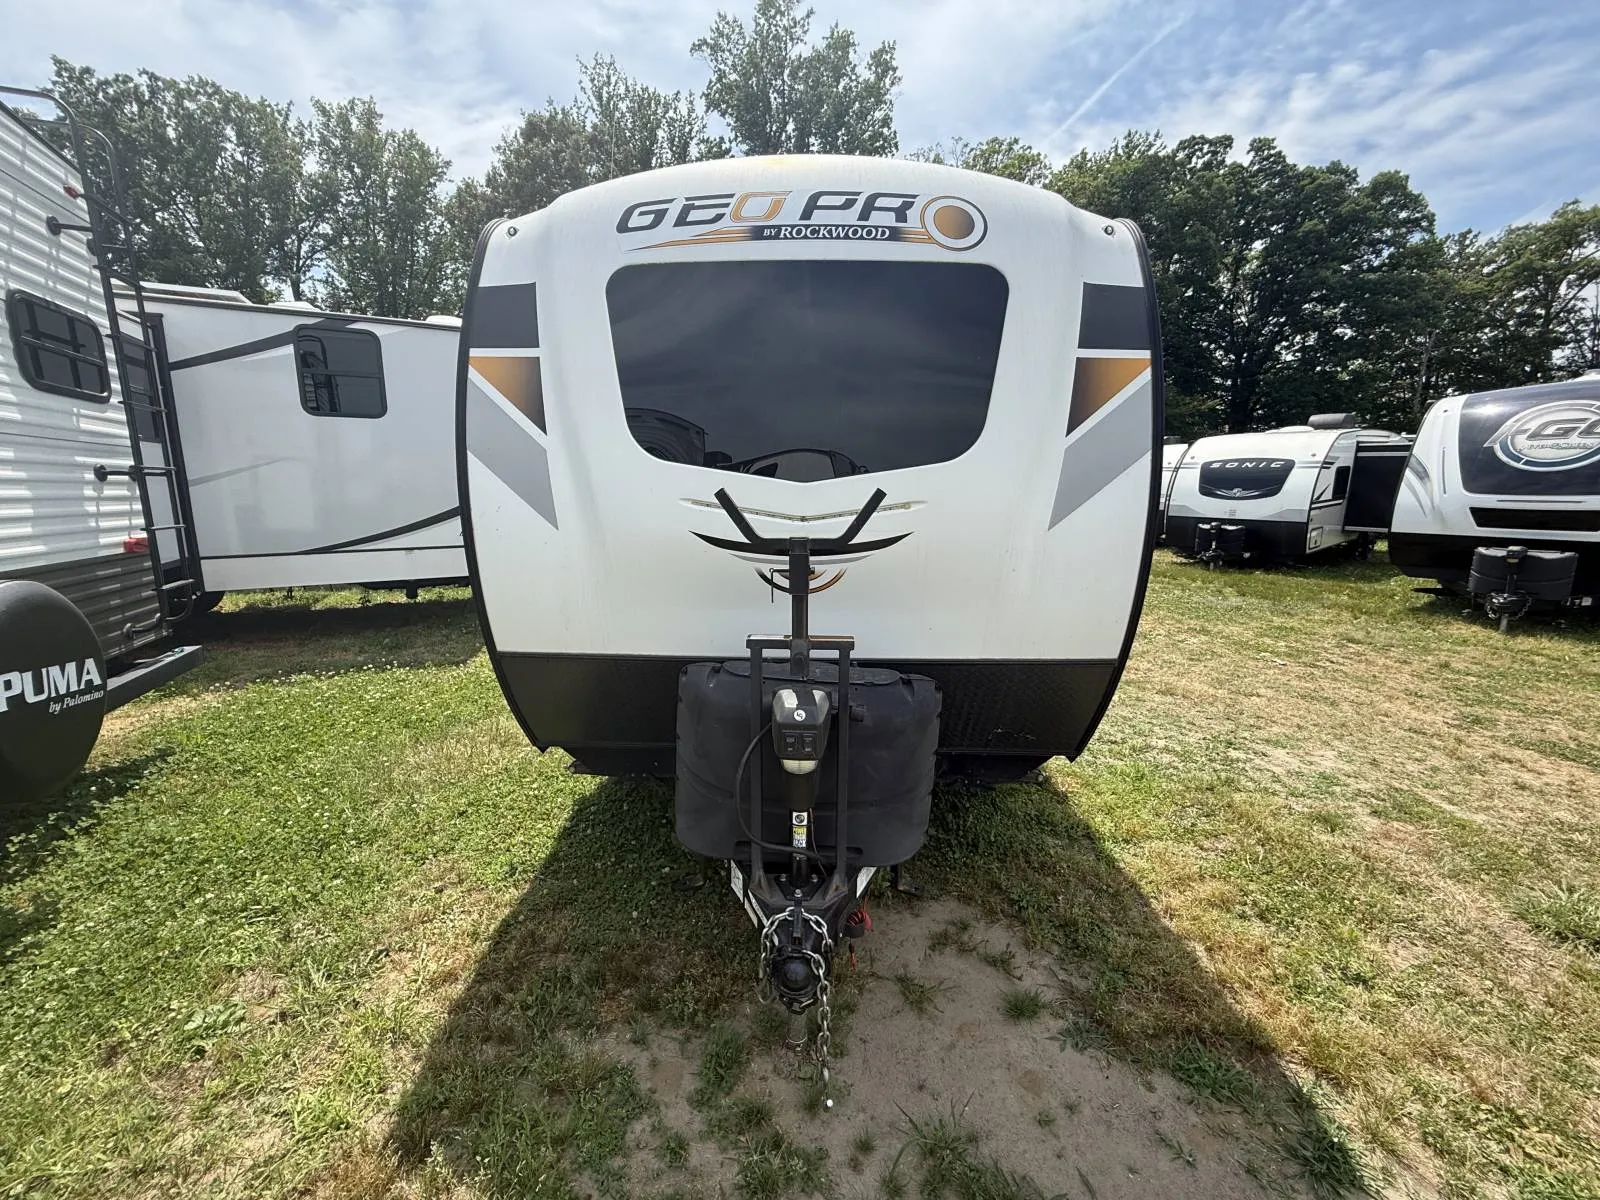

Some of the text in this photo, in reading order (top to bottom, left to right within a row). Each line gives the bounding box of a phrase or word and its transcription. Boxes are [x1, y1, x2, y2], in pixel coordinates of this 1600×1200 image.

[616, 191, 793, 234] GEO
[763, 226, 890, 240] BY ROCKWOOD
[1209, 461, 1286, 469] SONIC
[0, 658, 102, 713] PUMA
[49, 690, 104, 715] by Palomino
